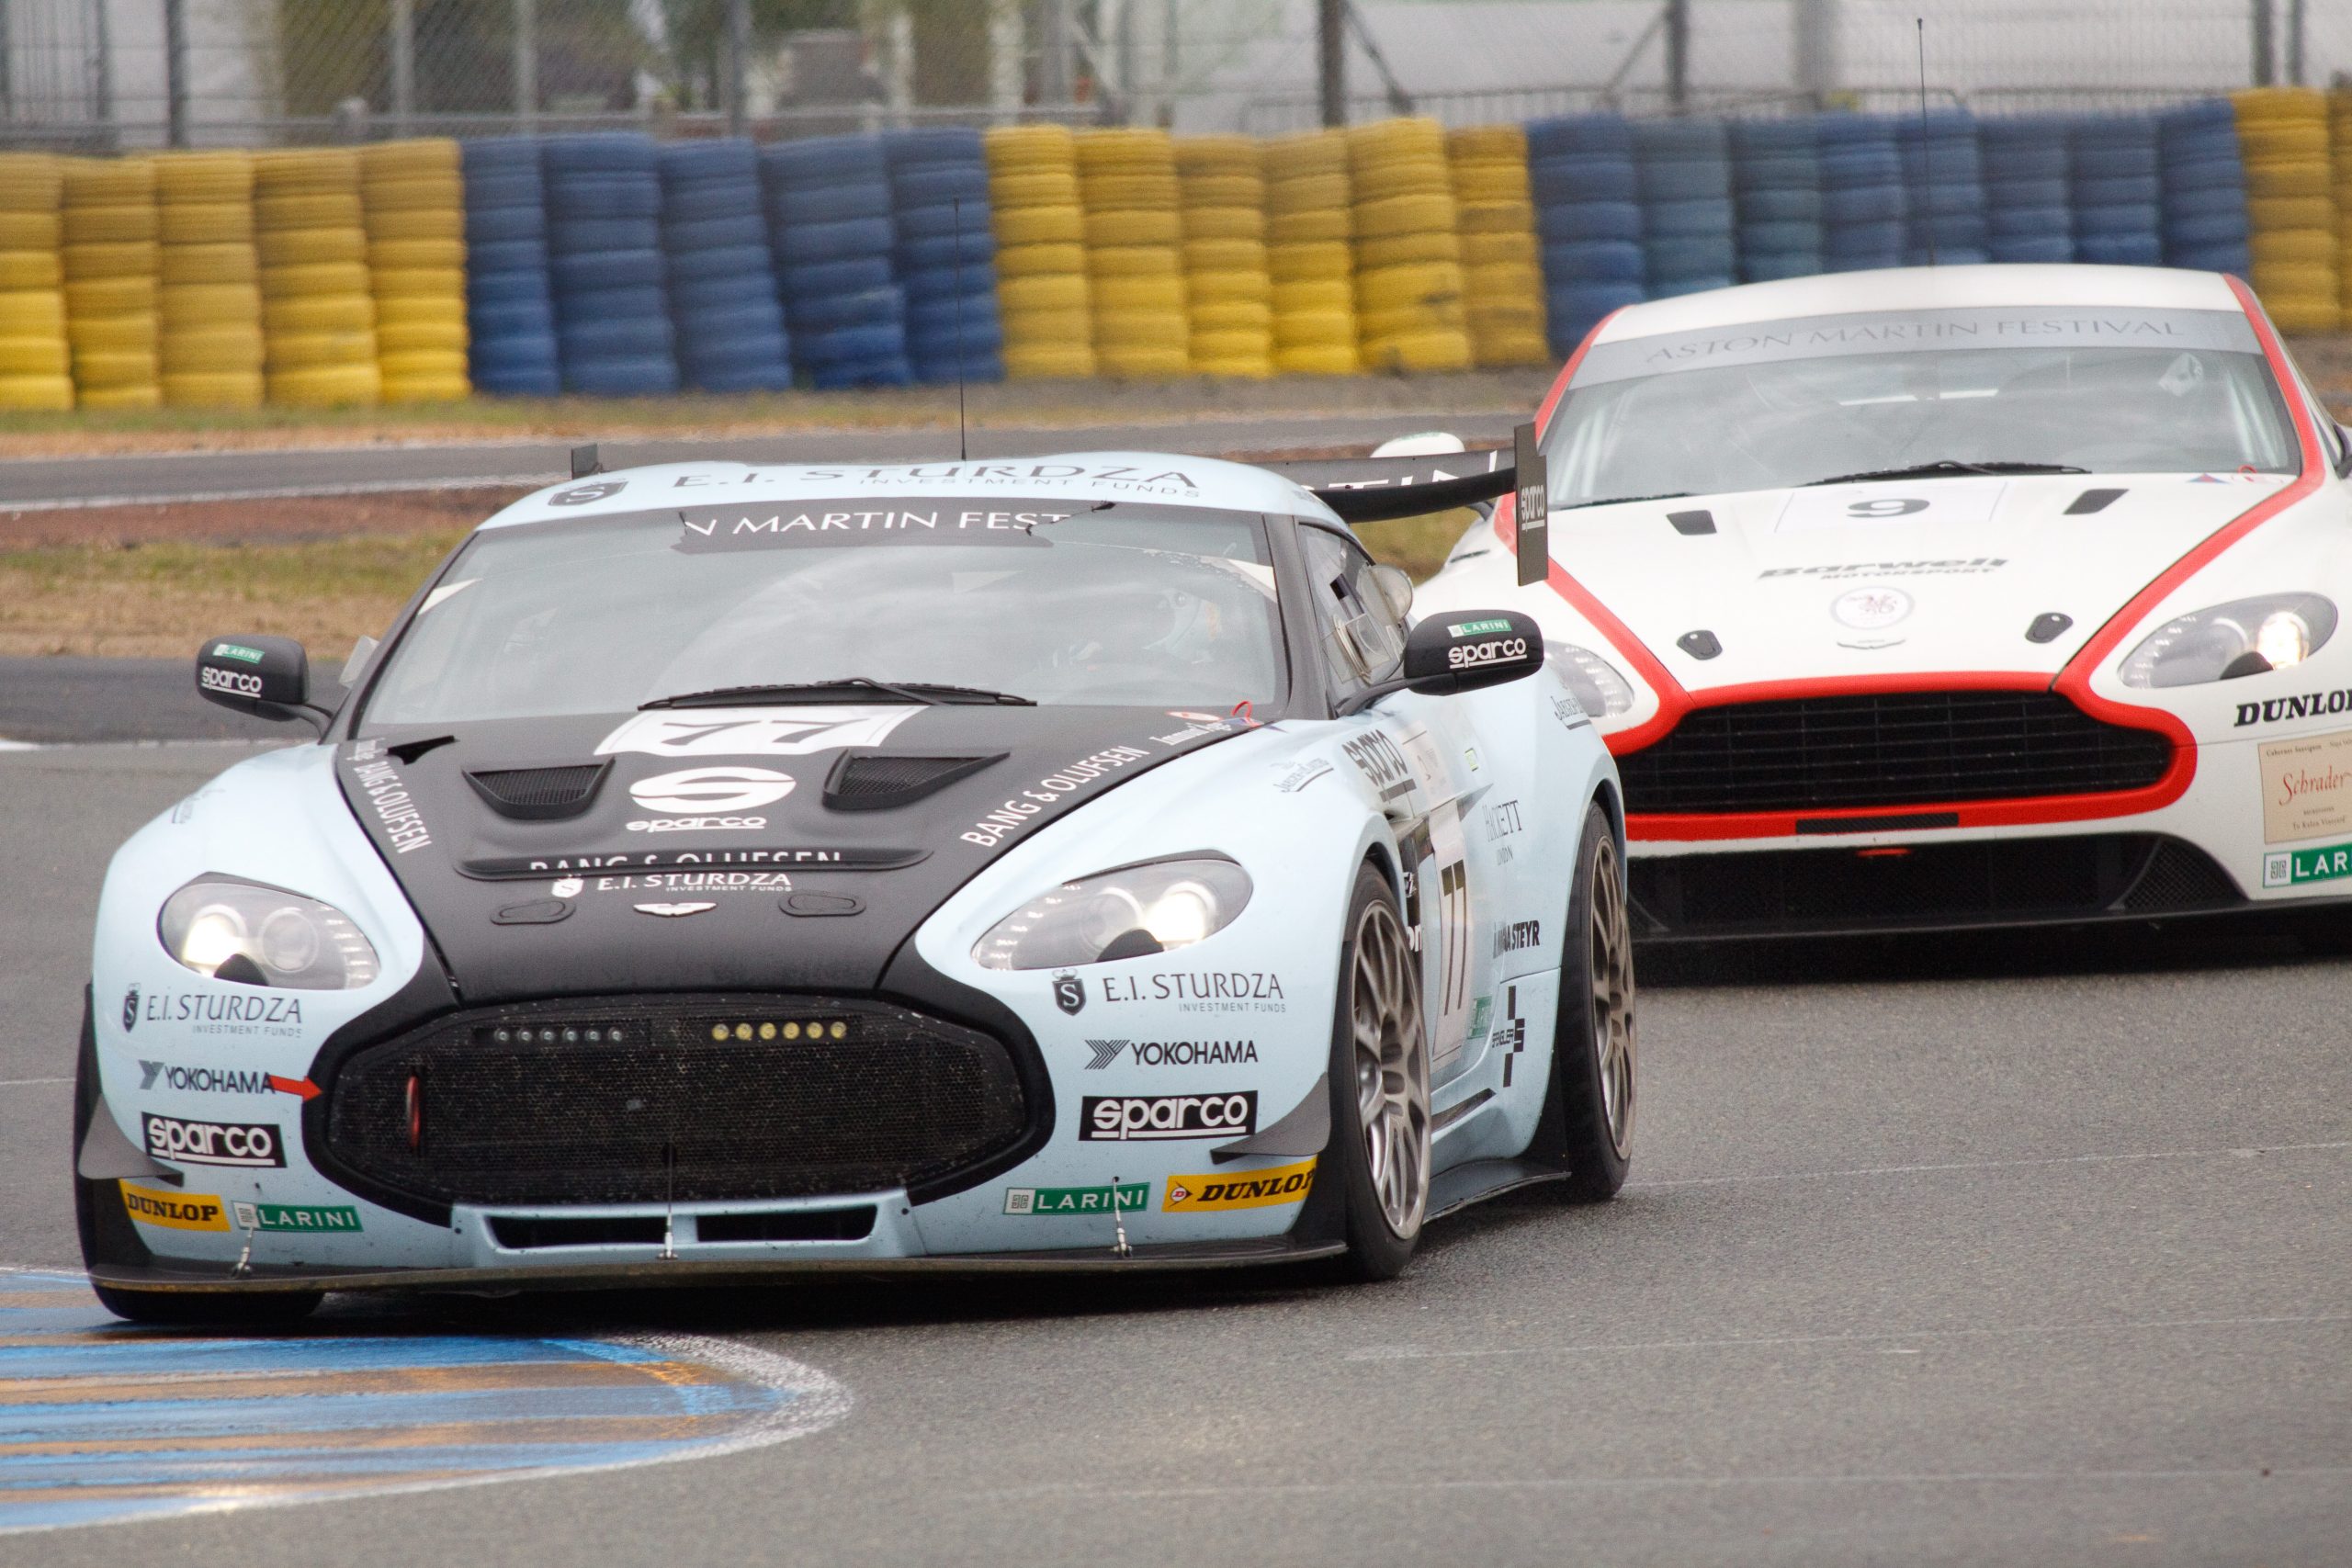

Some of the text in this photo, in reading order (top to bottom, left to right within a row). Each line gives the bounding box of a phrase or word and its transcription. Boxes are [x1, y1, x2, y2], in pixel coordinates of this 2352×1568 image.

[1647, 320, 2186, 364] ASTON MARTIN FESTIVAL
[673, 464, 1199, 489] E.I. STURDZA
[859, 477, 1201, 499] INVESTMENT FUNDS
[1847, 498, 1930, 518] 9
[732, 511, 938, 536] MARTIN
[1463, 620, 1510, 634] LARINI
[224, 645, 264, 661] LARINI
[1448, 637, 1527, 669] sparco
[201, 666, 263, 695] sparco
[2233, 688, 2352, 728] DUNLO
[661, 717, 872, 746] 77
[959, 745, 1151, 848] BANG & OLUFSEN
[2278, 764, 2350, 807] Schrader
[372, 790, 433, 854] OLUFSEN
[626, 816, 767, 833] sparco
[597, 873, 792, 891] E.I. STURDZA
[1441, 859, 1467, 1016] 77
[1511, 919, 1540, 951] STEYR
[1103, 972, 1284, 1002] E.I. STURDZA
[146, 992, 303, 1024] E.I. STURDZA
[1178, 1001, 1286, 1013] INVESTMENT FUNDS
[192, 1024, 303, 1038] INVESTMENT FUNDS
[1131, 1040, 1259, 1066] YOKOHAMA
[164, 1065, 277, 1095] YOKOHAMA
[1092, 1095, 1249, 1140] sparco
[149, 1117, 276, 1159] sparco
[127, 1193, 220, 1223] DUNLOP
[1037, 1189, 1143, 1210] LARINI
[260, 1207, 356, 1227] LARINI
